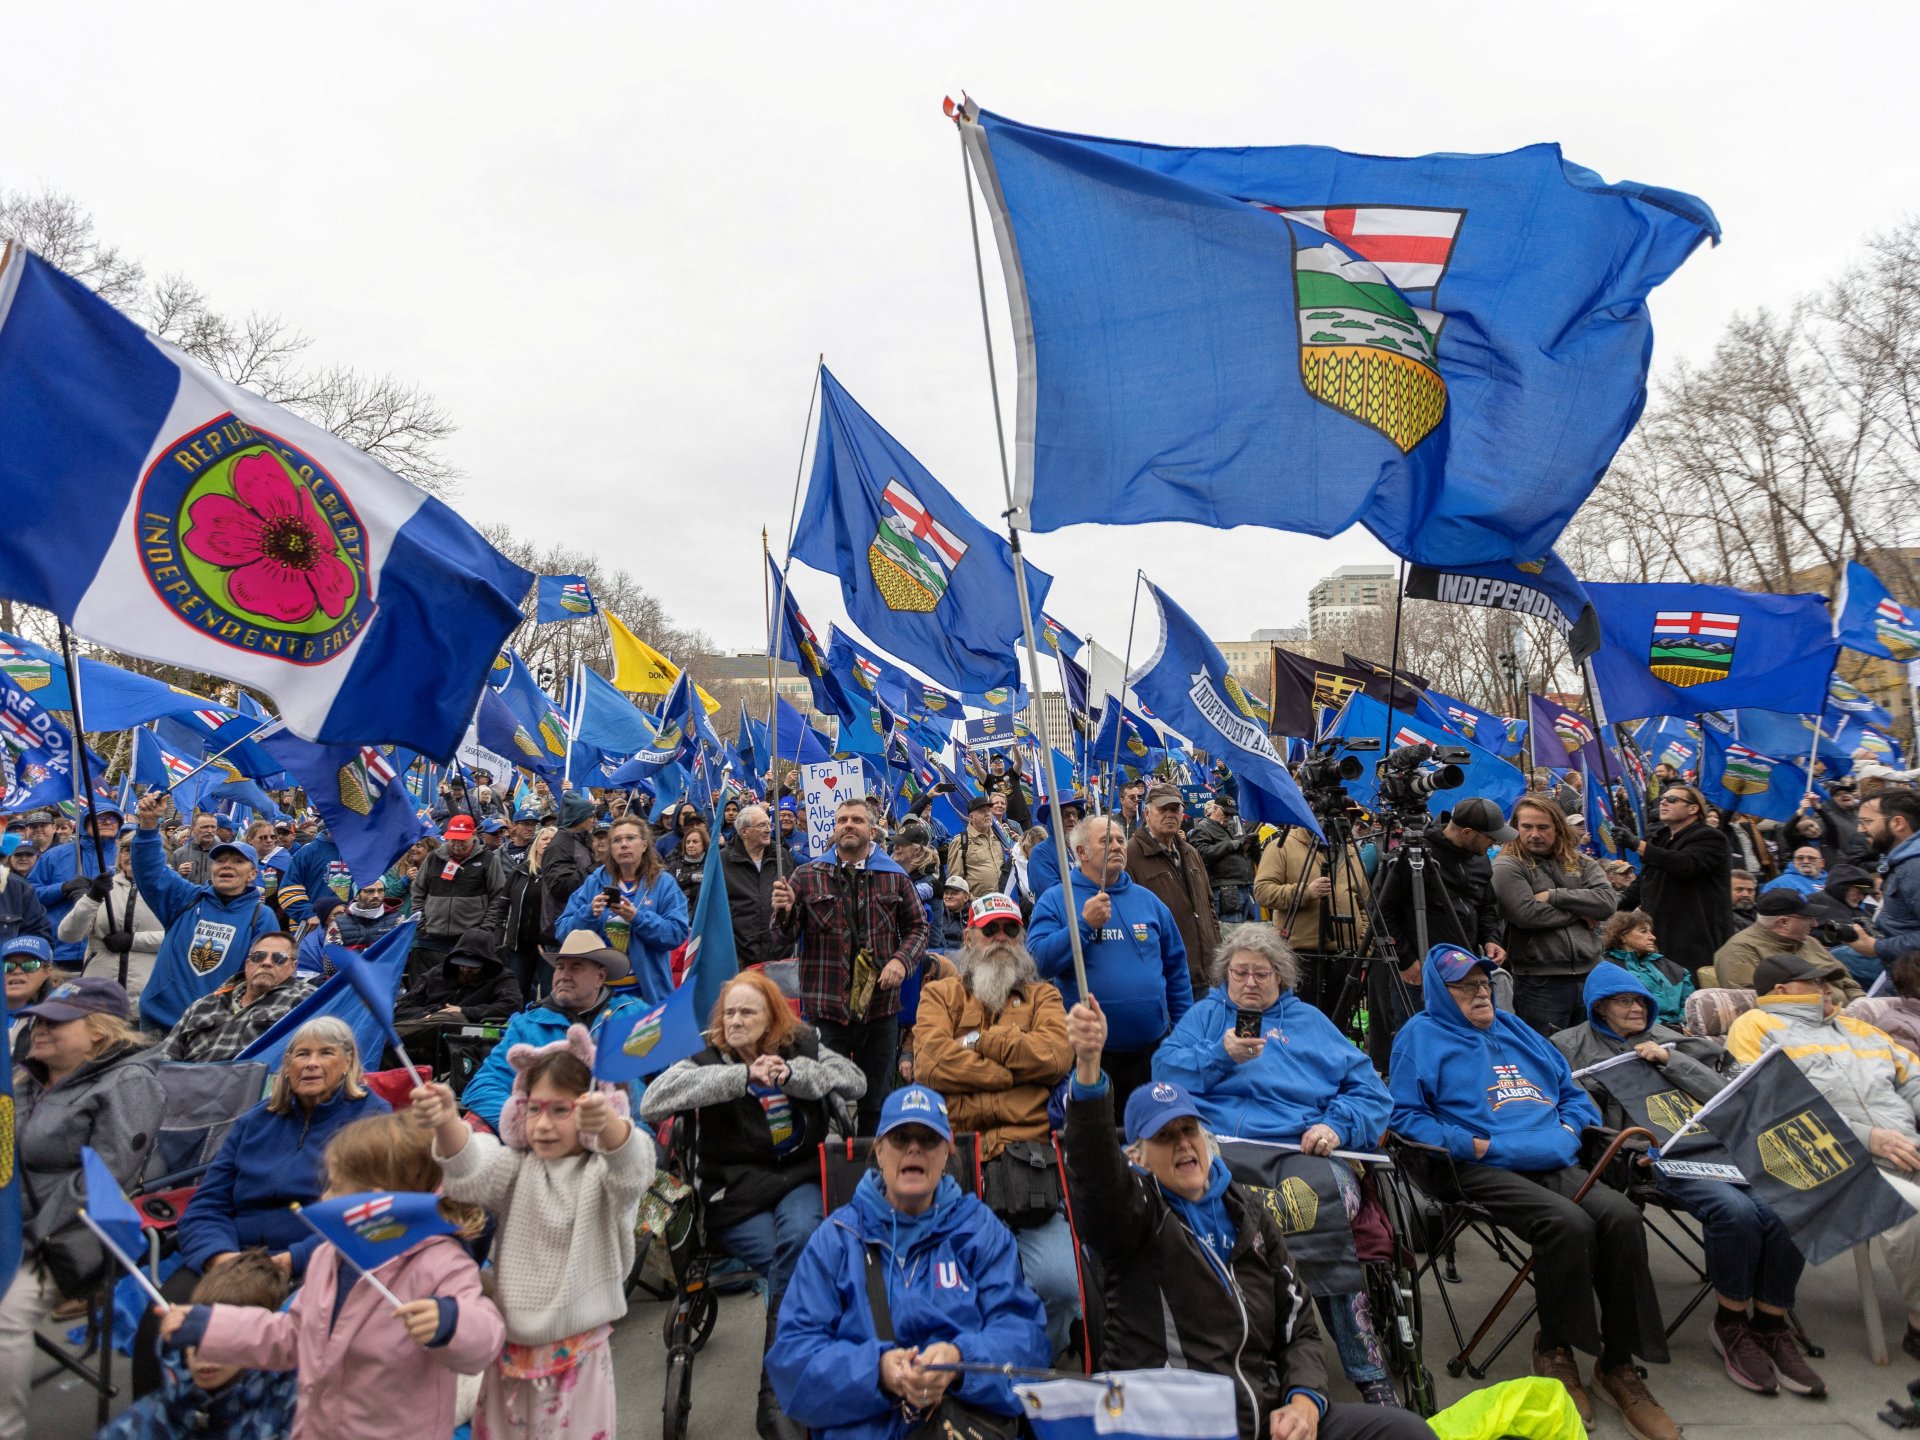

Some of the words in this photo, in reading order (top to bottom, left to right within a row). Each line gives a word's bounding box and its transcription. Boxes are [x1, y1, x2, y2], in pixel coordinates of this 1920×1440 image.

[174, 419, 263, 472] REPUB
[144, 512, 300, 655] INDEPENDENT
[303, 641, 316, 660] &
[323, 612, 364, 657] FREE
[1437, 573, 1575, 643] INDEPENDENT
[1193, 683, 1255, 747] INDEPENDENT
[0, 687, 36, 717] 'RE
[31, 712, 70, 775] DONE
[969, 735, 991, 743] CHOOSE
[990, 731, 1014, 741] ALBERTA
[810, 764, 833, 780] For
[837, 760, 859, 776] The
[807, 791, 822, 805] Of
[833, 787, 853, 803] All
[809, 805, 836, 820] Albe
[813, 818, 837, 833] Vot
[811, 833, 832, 851] Opt
[195, 927, 232, 941] ALBERTA
[1088, 928, 1125, 941] LERTA
[1496, 1086, 1544, 1101] ALBERTA
[1659, 1162, 1724, 1175] FOREVER
